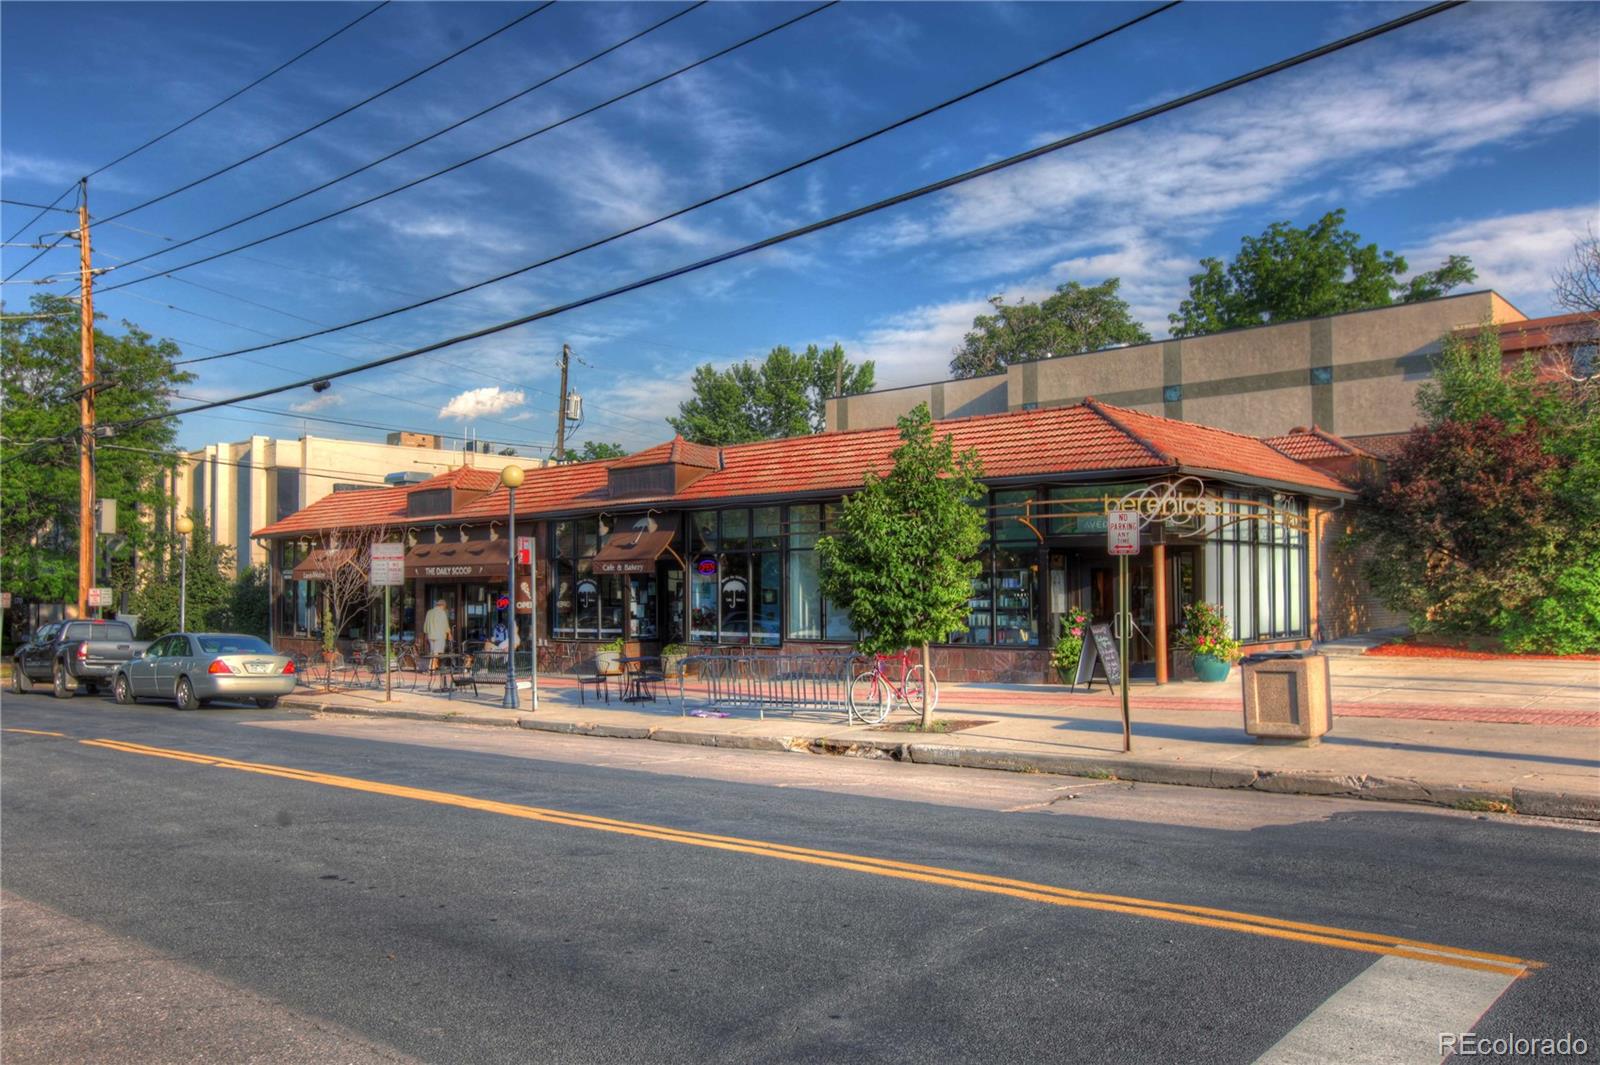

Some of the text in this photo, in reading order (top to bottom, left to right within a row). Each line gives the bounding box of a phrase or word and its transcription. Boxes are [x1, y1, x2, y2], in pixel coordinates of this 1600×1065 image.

[425, 566, 473, 576] THE DAILY SCOOP
[602, 564, 615, 572] Cafe
[624, 563, 644, 572] Bakery
